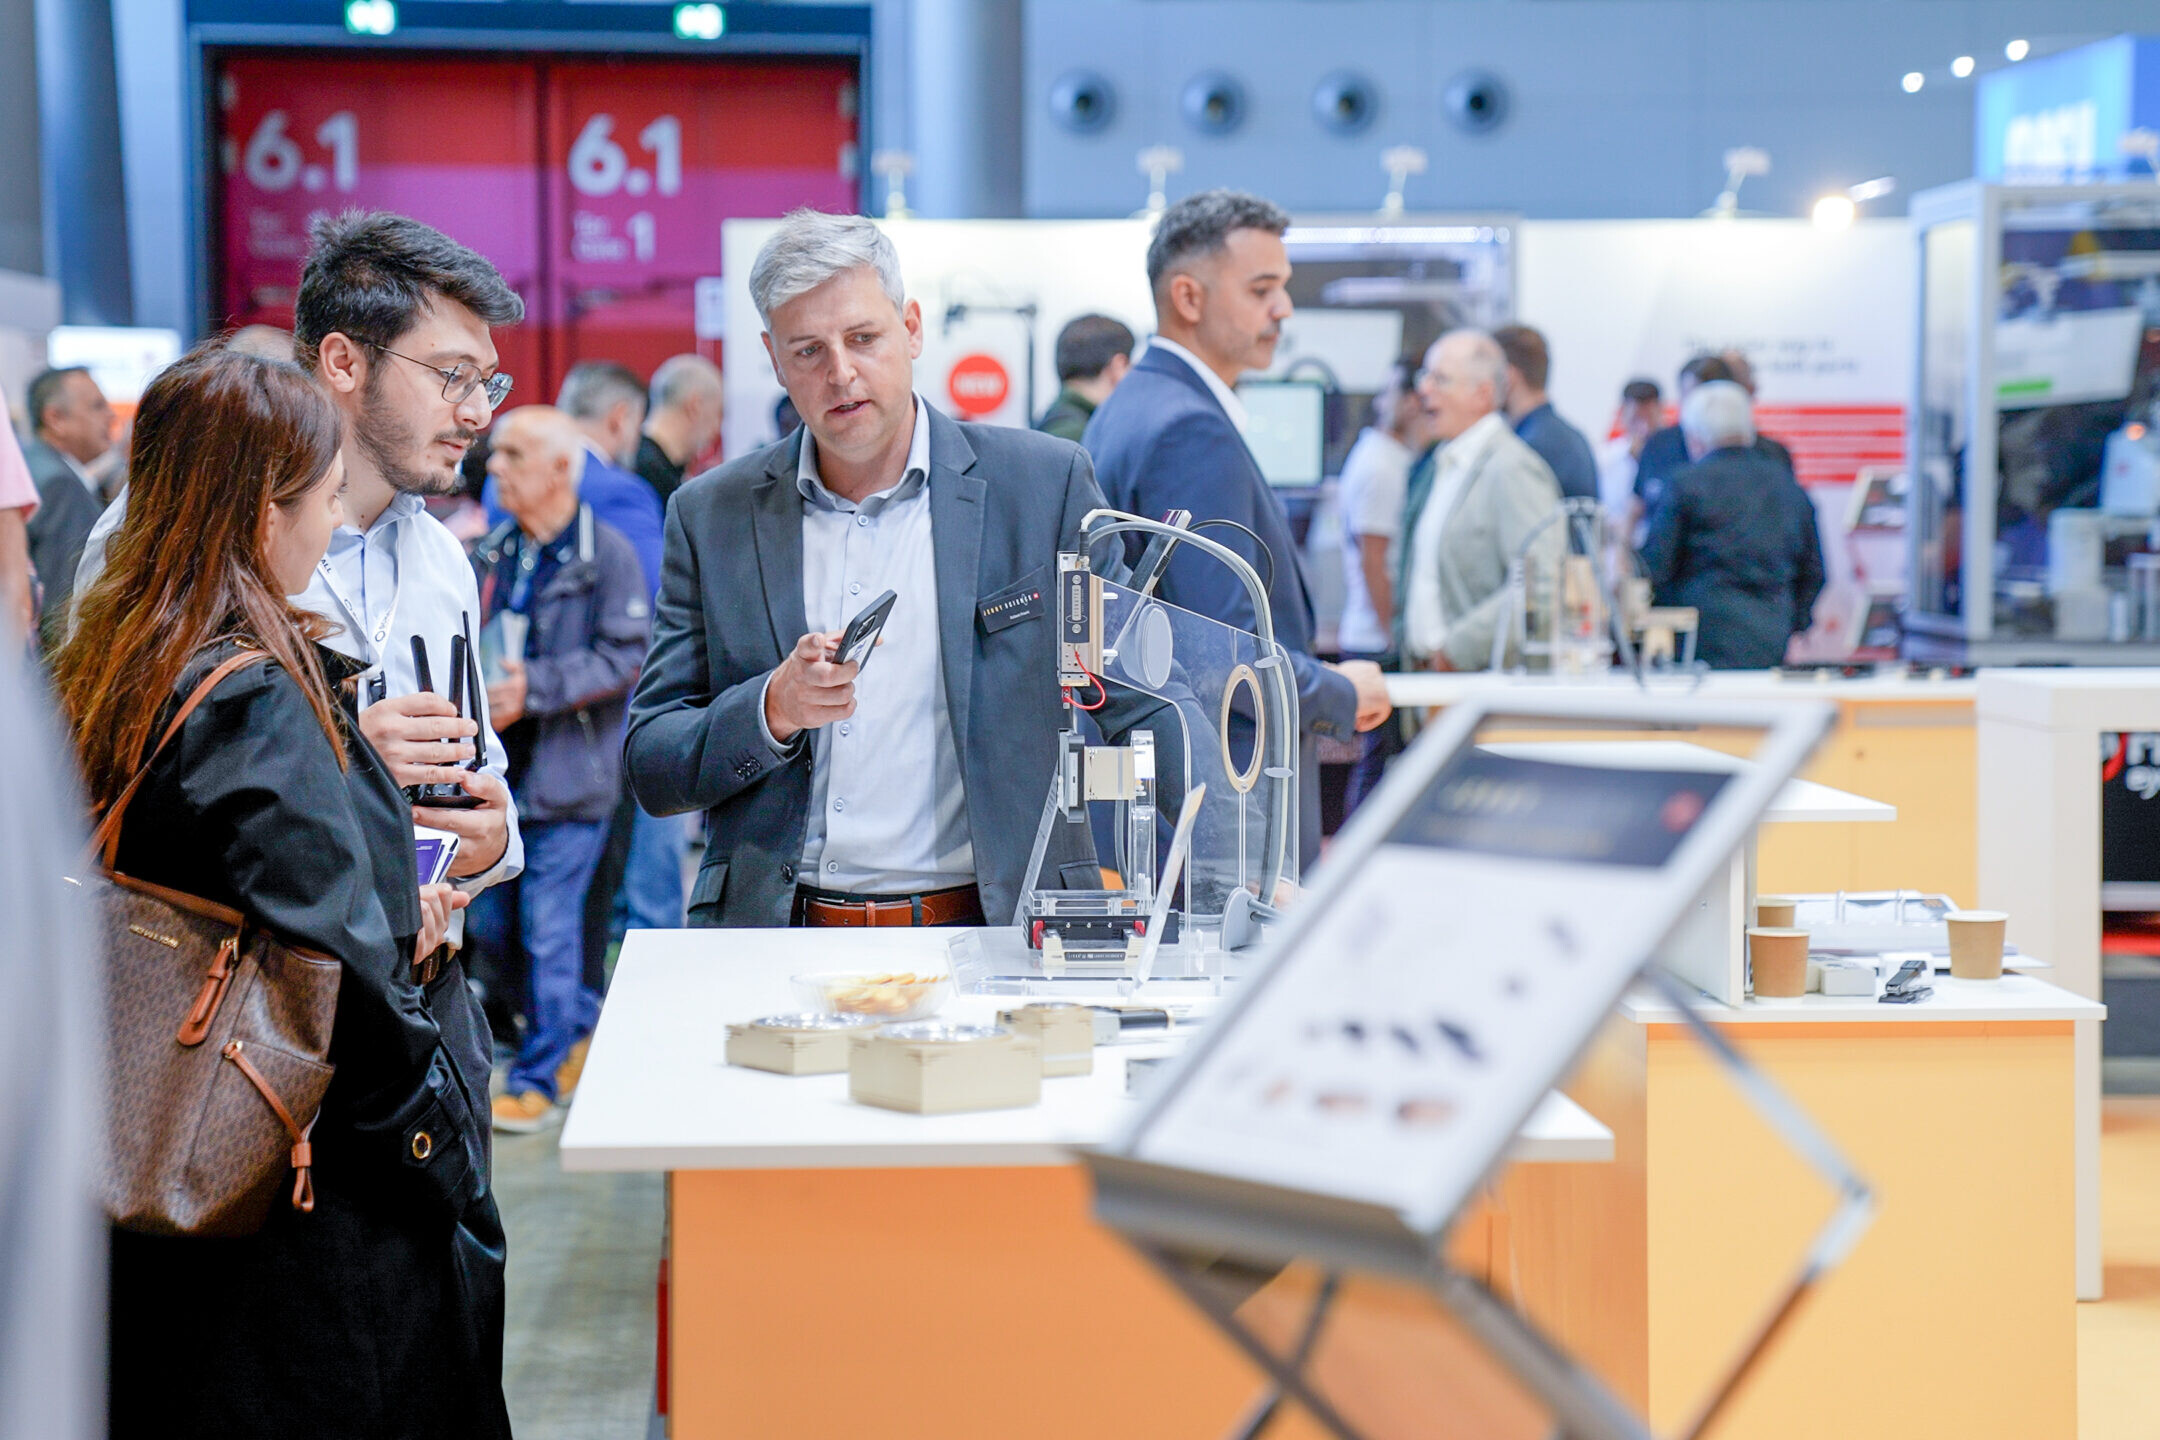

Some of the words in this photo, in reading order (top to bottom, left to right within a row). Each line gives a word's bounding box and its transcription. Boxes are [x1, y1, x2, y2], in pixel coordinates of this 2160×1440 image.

[245, 110, 358, 193] 6.1
[568, 113, 682, 197] 6.1
[627, 212, 655, 262] 1
